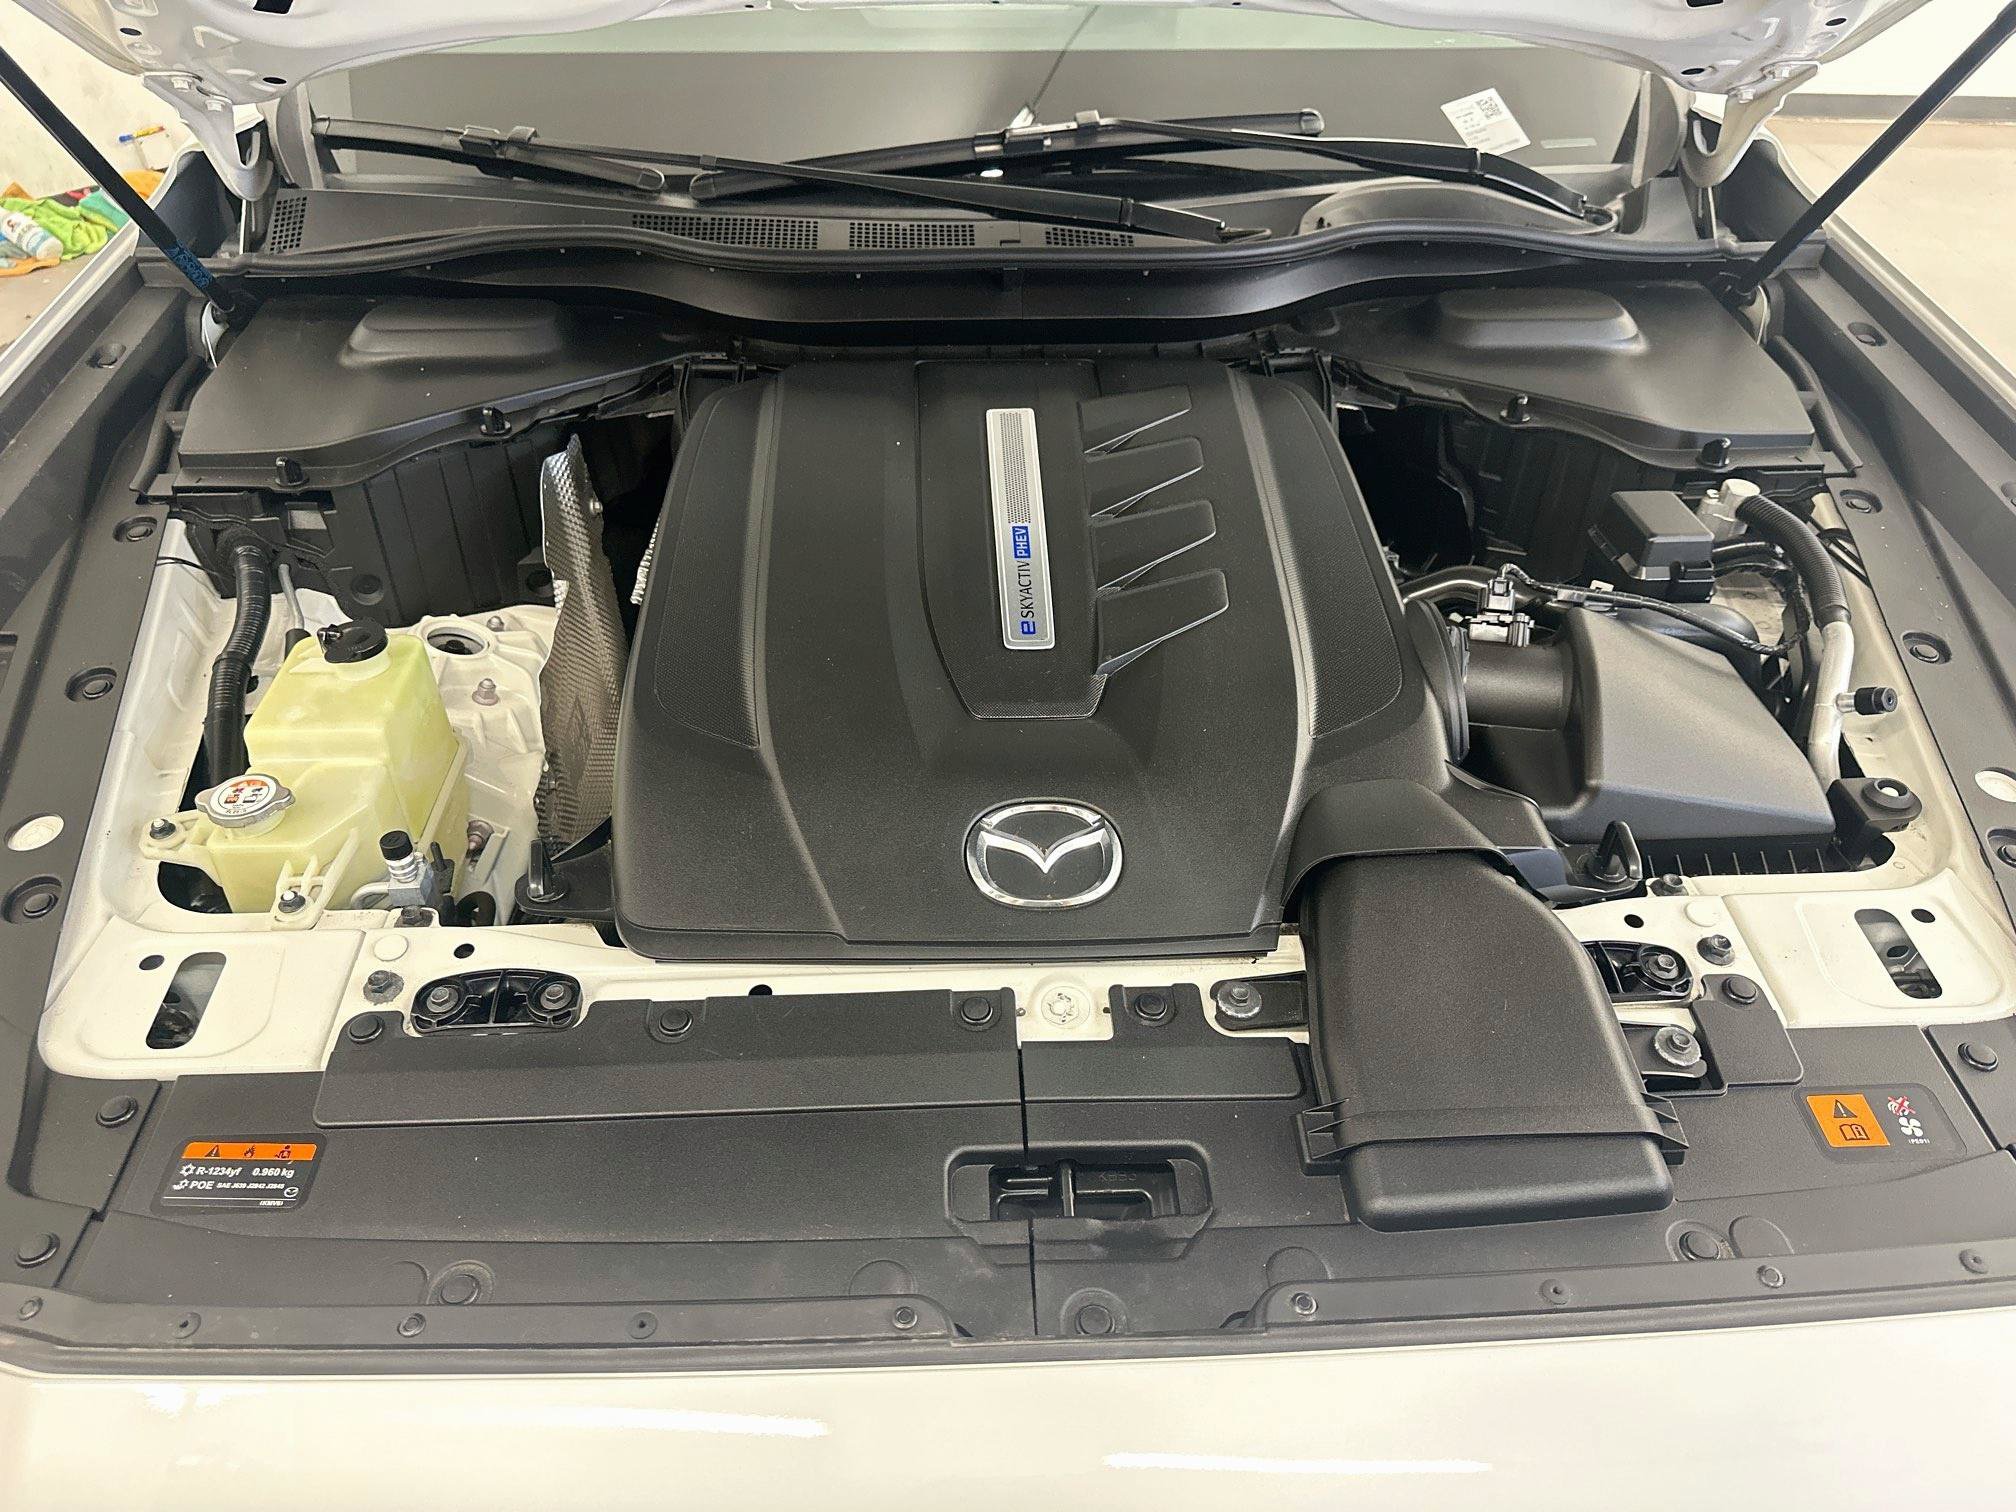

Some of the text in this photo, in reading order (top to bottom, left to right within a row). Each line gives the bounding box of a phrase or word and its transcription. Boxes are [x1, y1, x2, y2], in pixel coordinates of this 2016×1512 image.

[1014, 526, 1029, 557] PHEV
[1017, 560, 1035, 619] SKYACTIV
[195, 1167, 295, 1178] R-1234yf 0.960 kg
[190, 1180, 215, 1190] POE
